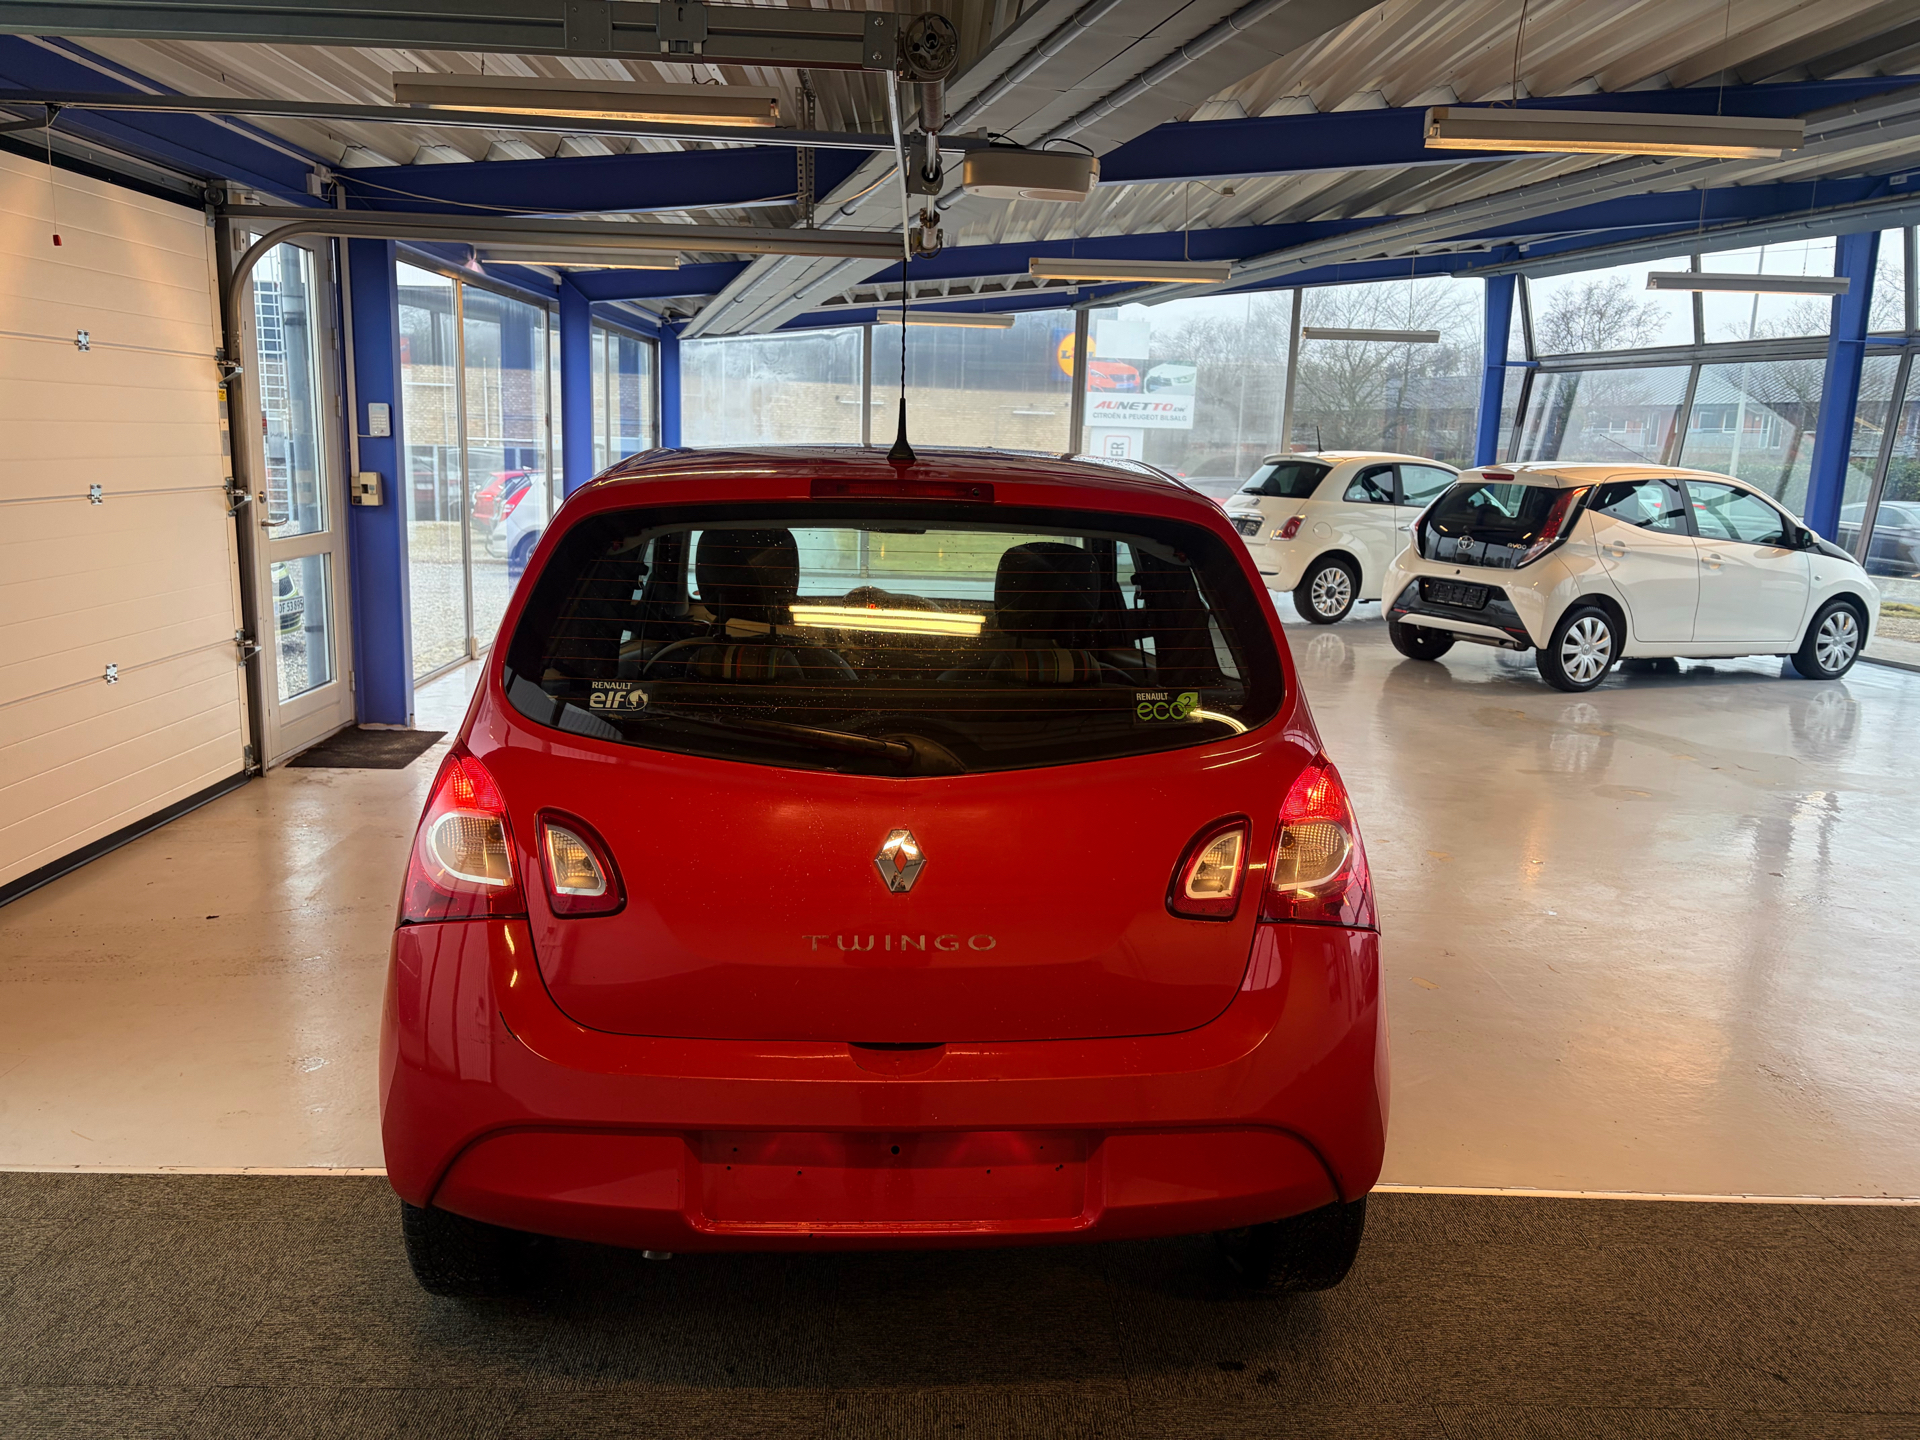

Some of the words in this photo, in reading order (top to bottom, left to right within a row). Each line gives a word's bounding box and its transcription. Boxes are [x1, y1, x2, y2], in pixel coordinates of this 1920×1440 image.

[1093, 412, 1121, 420] CITROËN
[1129, 413, 1158, 421] PEUGEOT
[1160, 414, 1187, 422] BILSALG
[591, 681, 632, 690] RENAULT
[589, 691, 627, 709] elf
[1136, 692, 1169, 701] RENAULT
[801, 934, 997, 952] TWINGO
